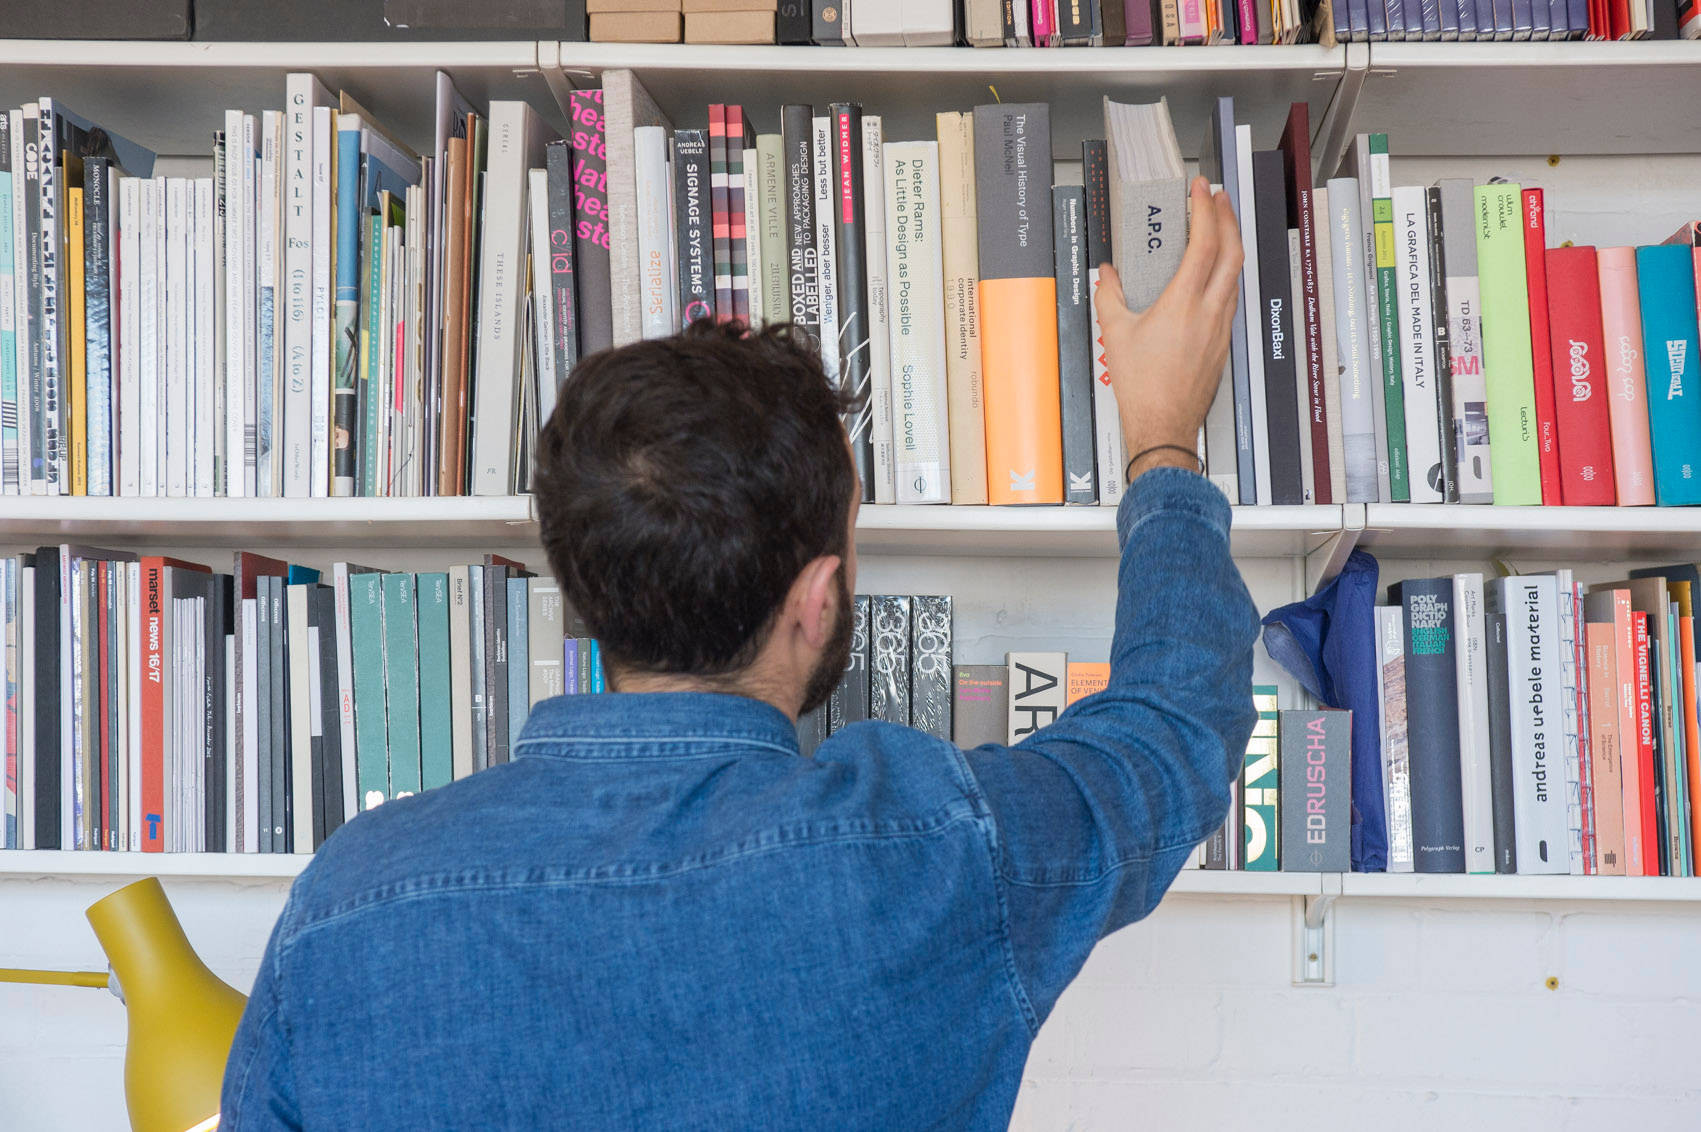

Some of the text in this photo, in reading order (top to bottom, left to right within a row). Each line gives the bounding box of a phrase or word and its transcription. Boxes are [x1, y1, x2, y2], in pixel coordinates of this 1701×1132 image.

[25, 143, 38, 181] CODE
[293, 93, 305, 217] GESTALT
[816, 129, 828, 200] Less but better
[841, 115, 852, 200] JEAN WIDMER
[1003, 114, 1014, 176] Paul McNeil
[93, 164, 101, 206] MONOCLE
[792, 163, 803, 246] NEW APPROACHES
[800, 141, 811, 244] TO PACKAGING DESIGN
[912, 159, 925, 243] Dieter Rams:
[1015, 114, 1030, 248] The Visual History of Type
[1301, 190, 1309, 209] JOHN
[31, 232, 39, 272] Documenting
[686, 163, 703, 294] SIGNAGE SYSTEMS
[768, 208, 779, 238] VILLE
[895, 159, 912, 336] As Little Design as Possible
[1069, 198, 1081, 305] Numbers Graphic Design
[1147, 205, 1162, 254] A.P.C.
[493, 252, 505, 340] THESE ISLANDS
[648, 250, 664, 314] Serialize
[791, 248, 806, 325] BOXED AND
[805, 247, 819, 325] LABELLED
[820, 223, 834, 325] Weniger, aber besser
[1406, 212, 1425, 389] LA GRAFICA DEL MADE IN ITALY
[877, 287, 886, 324] typography
[958, 277, 968, 360] corporate identity
[968, 277, 977, 338] international
[1269, 298, 1285, 360] DixonBaxi
[1307, 296, 1316, 323] Dedham
[1309, 324, 1318, 336] Vale
[1460, 300, 1470, 316] TD
[1310, 337, 1319, 352] with
[1311, 353, 1319, 362] the
[1311, 362, 1320, 379] River
[902, 364, 917, 451] Sophie Lovell
[970, 371, 979, 409] robundo
[1314, 405, 1323, 423] Flood
[1009, 469, 1035, 491] K
[1070, 471, 1092, 493] K
[148, 567, 160, 684] marset news 16/17
[1410, 595, 1438, 604] POLY
[1410, 603, 1448, 612] GRAPH
[1411, 611, 1446, 620] DICTIO
[1412, 619, 1442, 628] NARY
[1411, 627, 1448, 635] ENGLISH
[1524, 584, 1548, 802] andreas uebele material
[1637, 617, 1651, 745] THE VIGNELLI CANON
